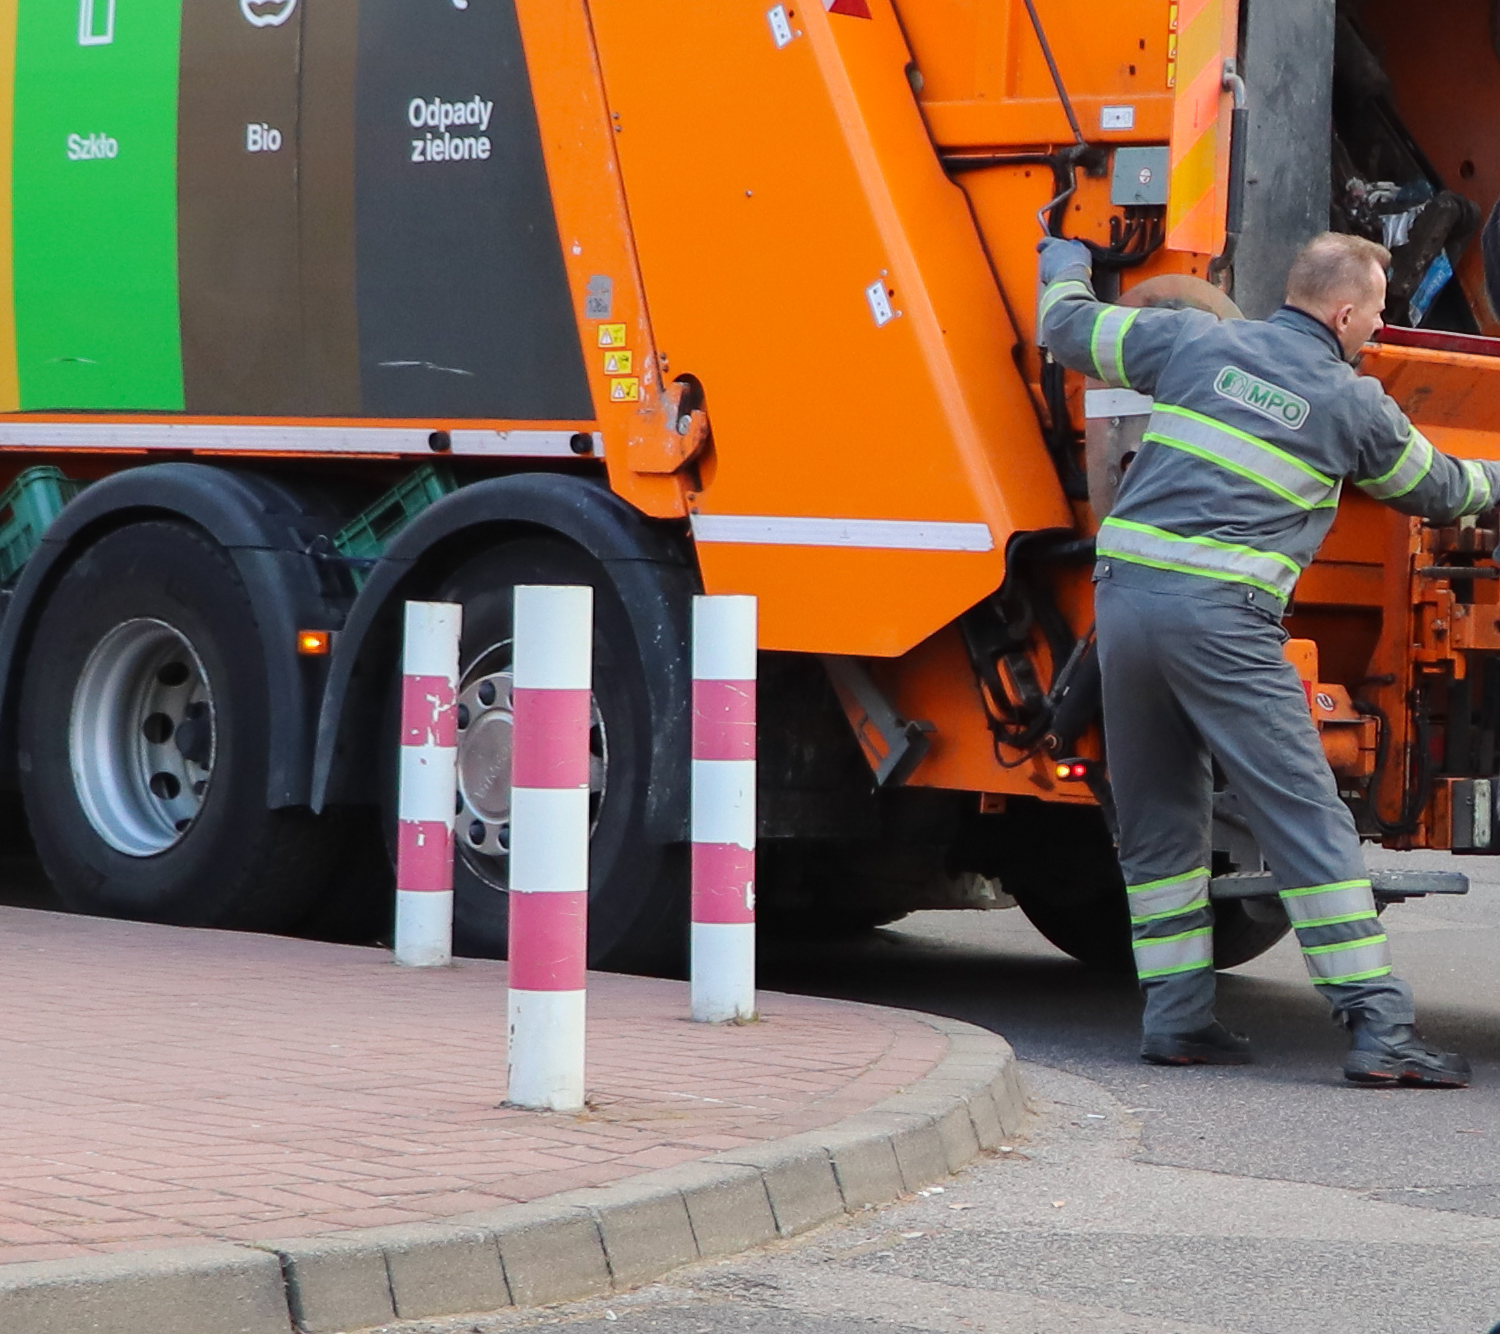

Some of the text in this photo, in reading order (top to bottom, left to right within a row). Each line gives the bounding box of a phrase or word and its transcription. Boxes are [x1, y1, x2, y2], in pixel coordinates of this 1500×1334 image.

[408, 94, 494, 133] Odpady
[67, 132, 118, 160] Szkło
[246, 122, 282, 152] Bio
[411, 131, 491, 162] zielone
[1247, 385, 1300, 421] MPO
